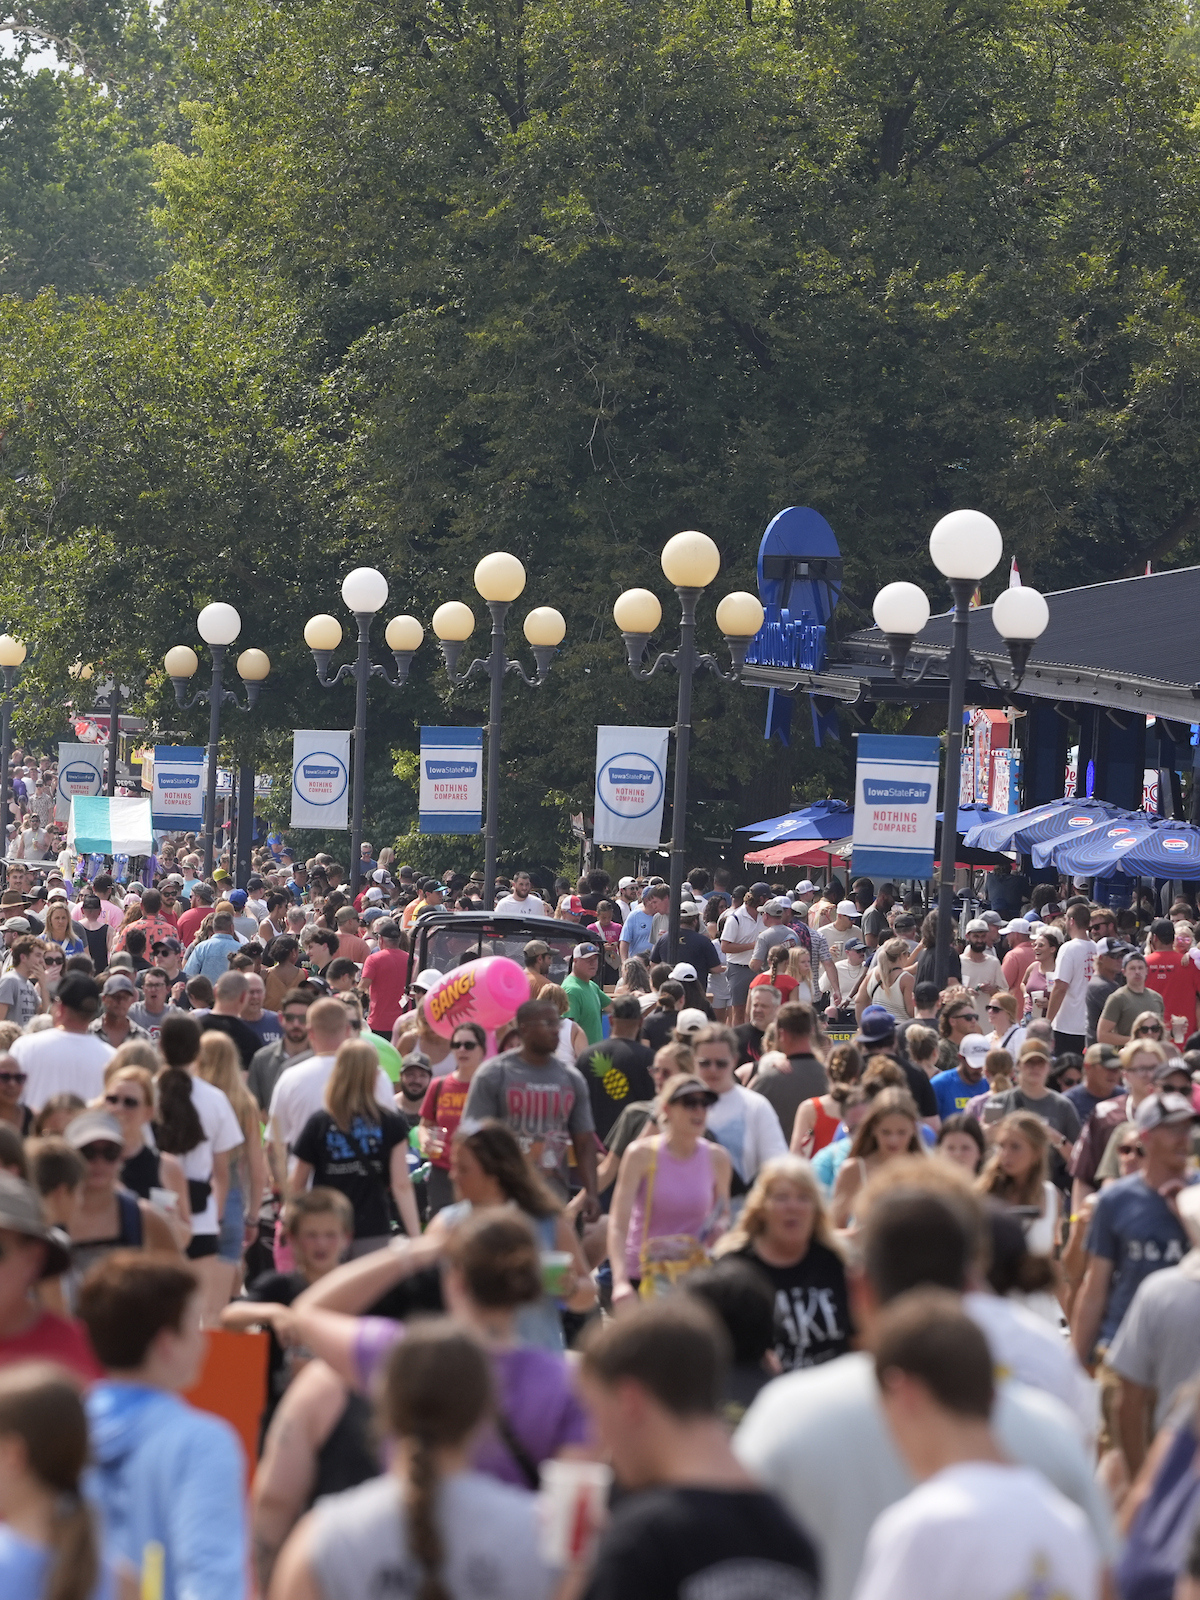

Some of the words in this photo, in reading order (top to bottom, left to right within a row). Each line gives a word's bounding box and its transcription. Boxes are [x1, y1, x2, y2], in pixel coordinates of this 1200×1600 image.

[429, 766, 475, 774] IowaStateFair
[161, 777, 197, 785] IowaStateFair
[434, 784, 468, 792] NOTHING
[615, 787, 645, 797] NOTHING
[867, 787, 927, 798] IowaStateFair
[615, 795, 645, 803] COMPARES
[873, 810, 917, 822] NOTHING
[872, 822, 917, 833] COMPARES
[430, 969, 476, 1022] BANG!
